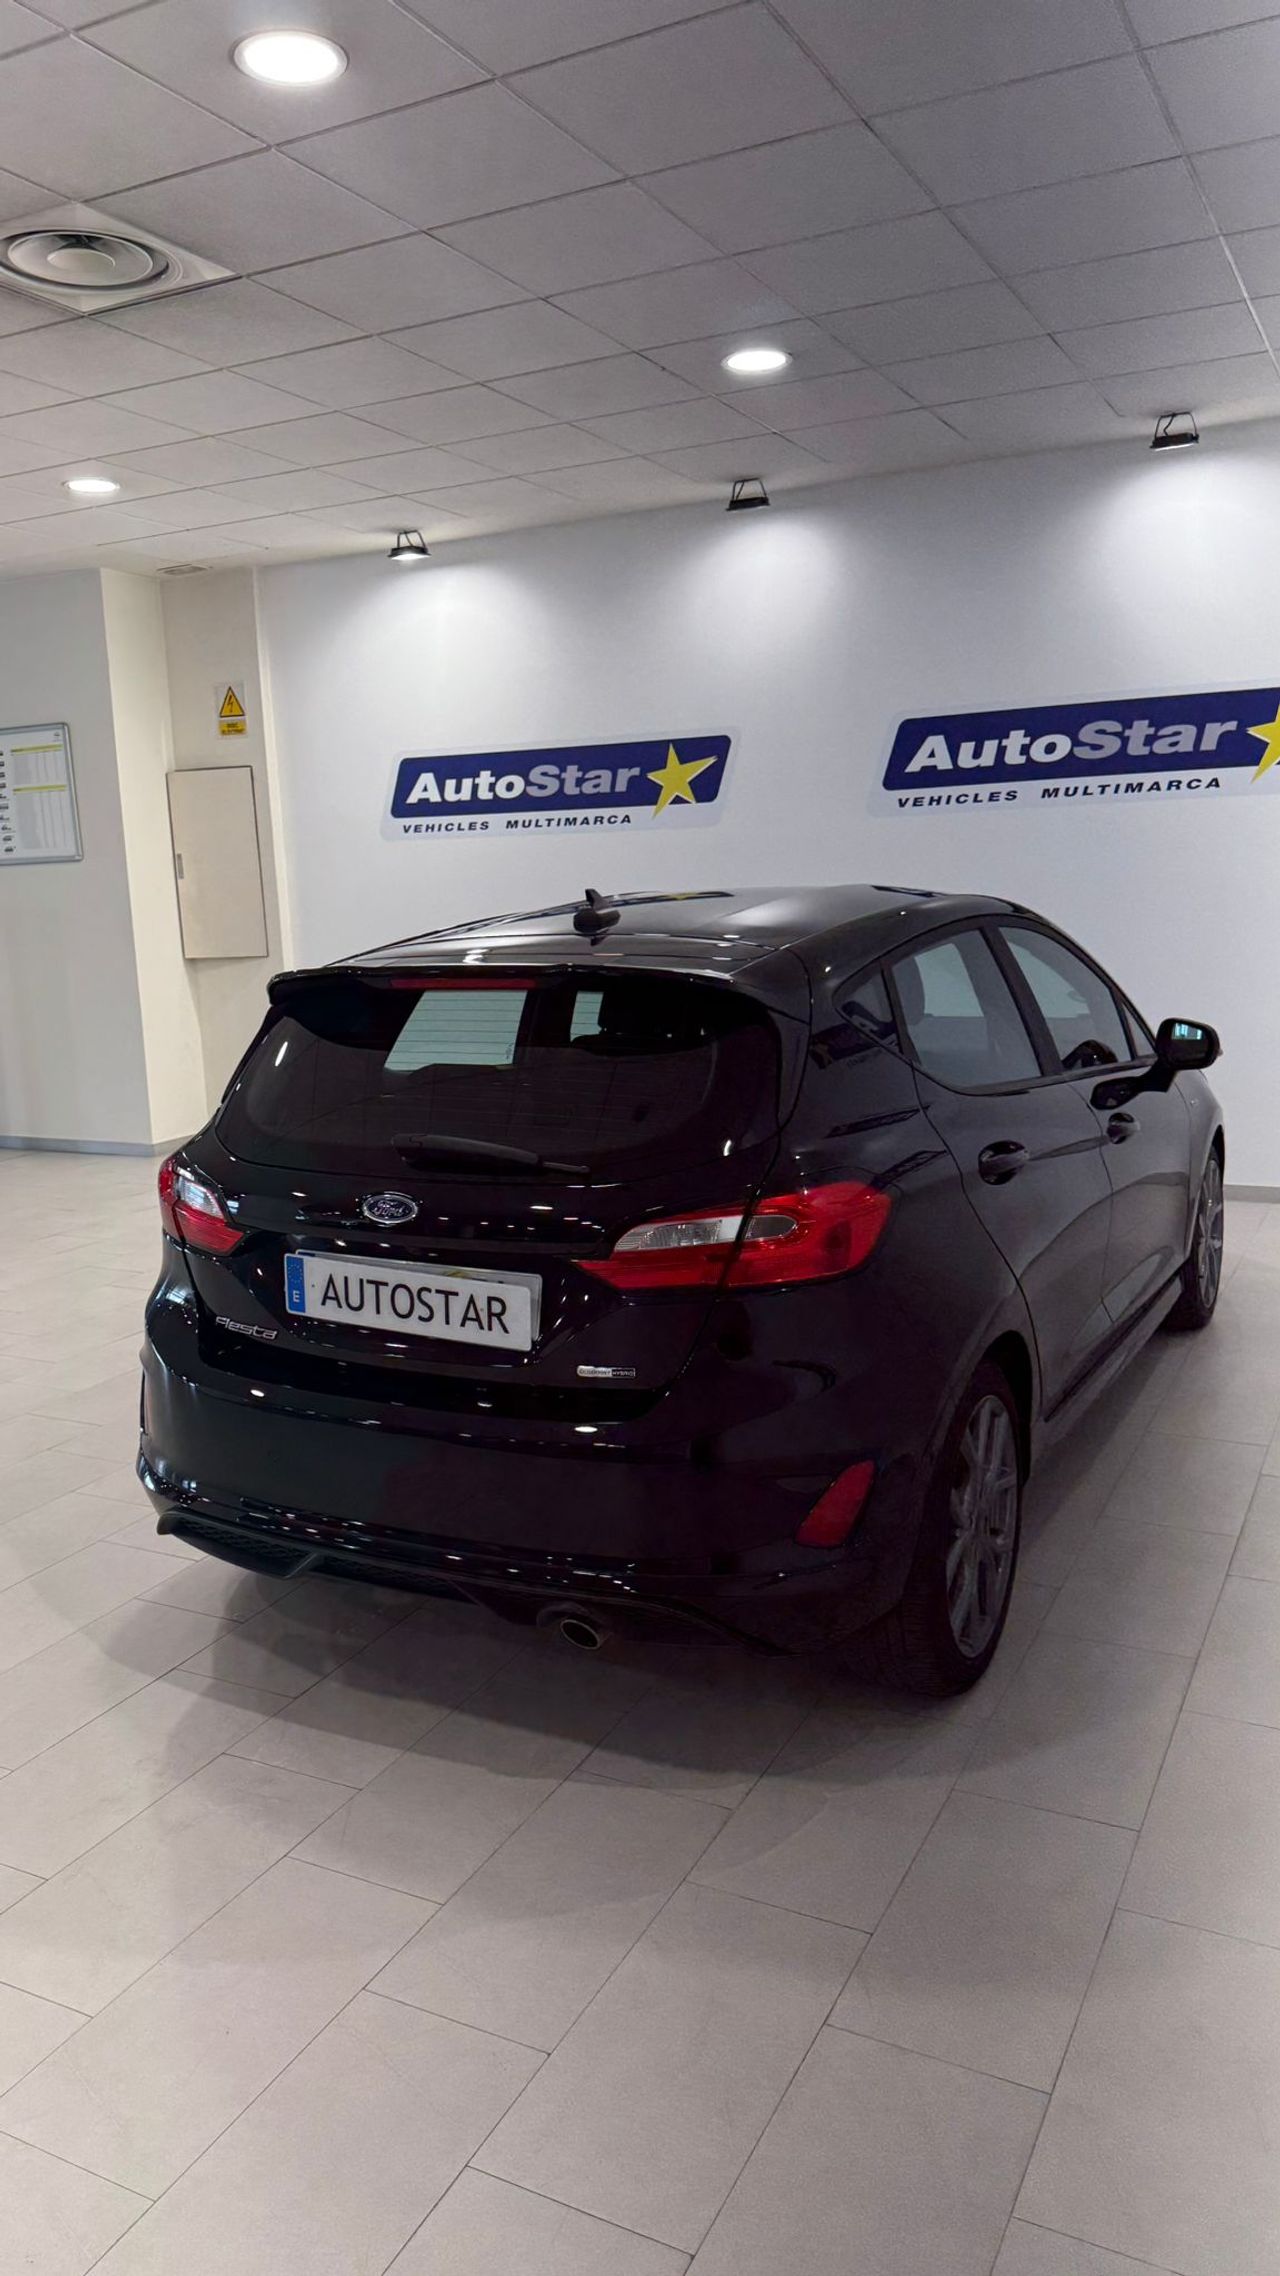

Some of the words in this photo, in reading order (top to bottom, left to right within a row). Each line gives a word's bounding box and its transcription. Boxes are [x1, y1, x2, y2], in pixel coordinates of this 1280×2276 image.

[904, 719, 1239, 773] AutoStar
[405, 764, 641, 804] AutoStar
[897, 789, 1019, 809] VEHICLES
[1040, 776, 1222, 799] MULTIMARCA
[402, 820, 490, 835] VEHICLES
[505, 813, 632, 829] MULTIMARCA
[292, 1290, 300, 1303] E
[321, 1273, 510, 1335] AUTOSTAR
